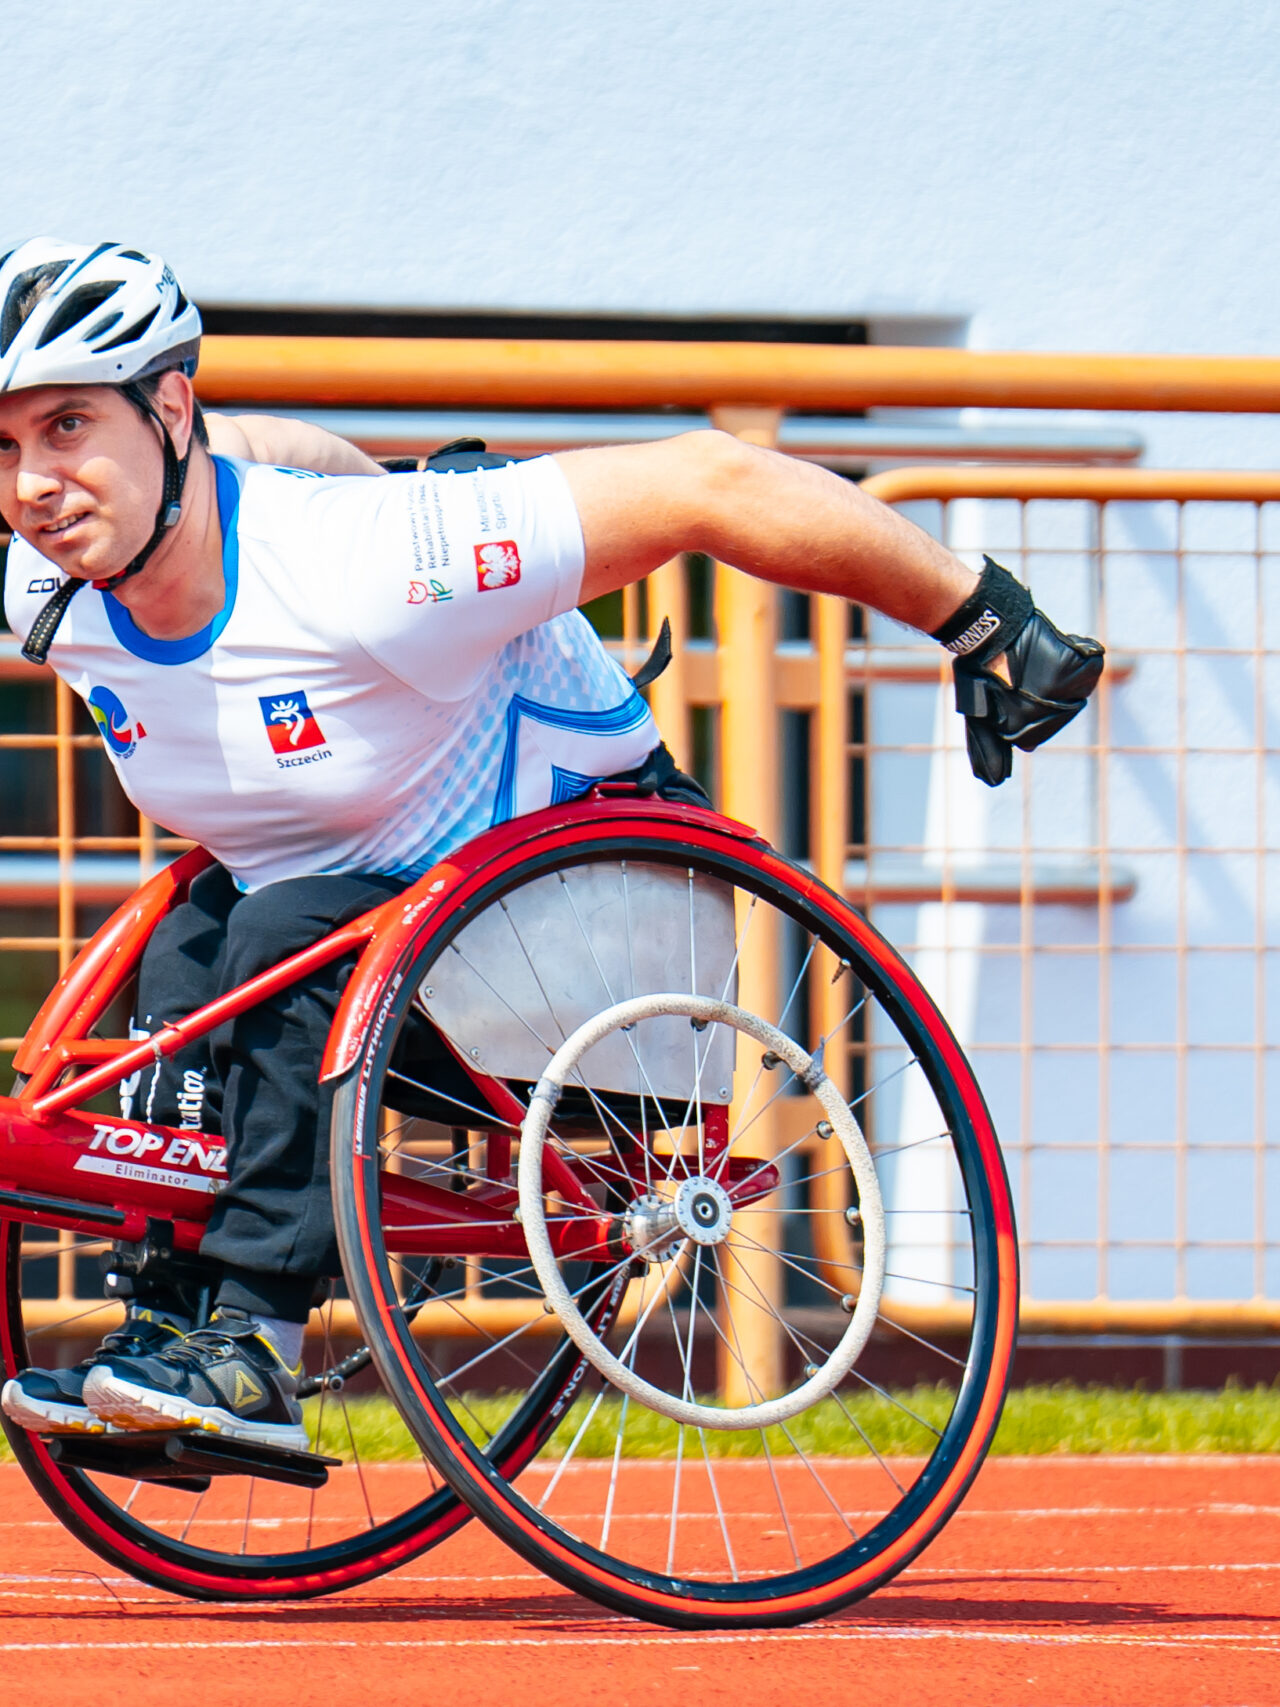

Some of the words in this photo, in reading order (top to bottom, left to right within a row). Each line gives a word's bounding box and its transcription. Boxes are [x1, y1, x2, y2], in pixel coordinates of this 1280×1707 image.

[276, 749, 333, 769] Szczecin
[89, 1124, 164, 1158] TOP
[115, 1163, 189, 1187] Eliminator
